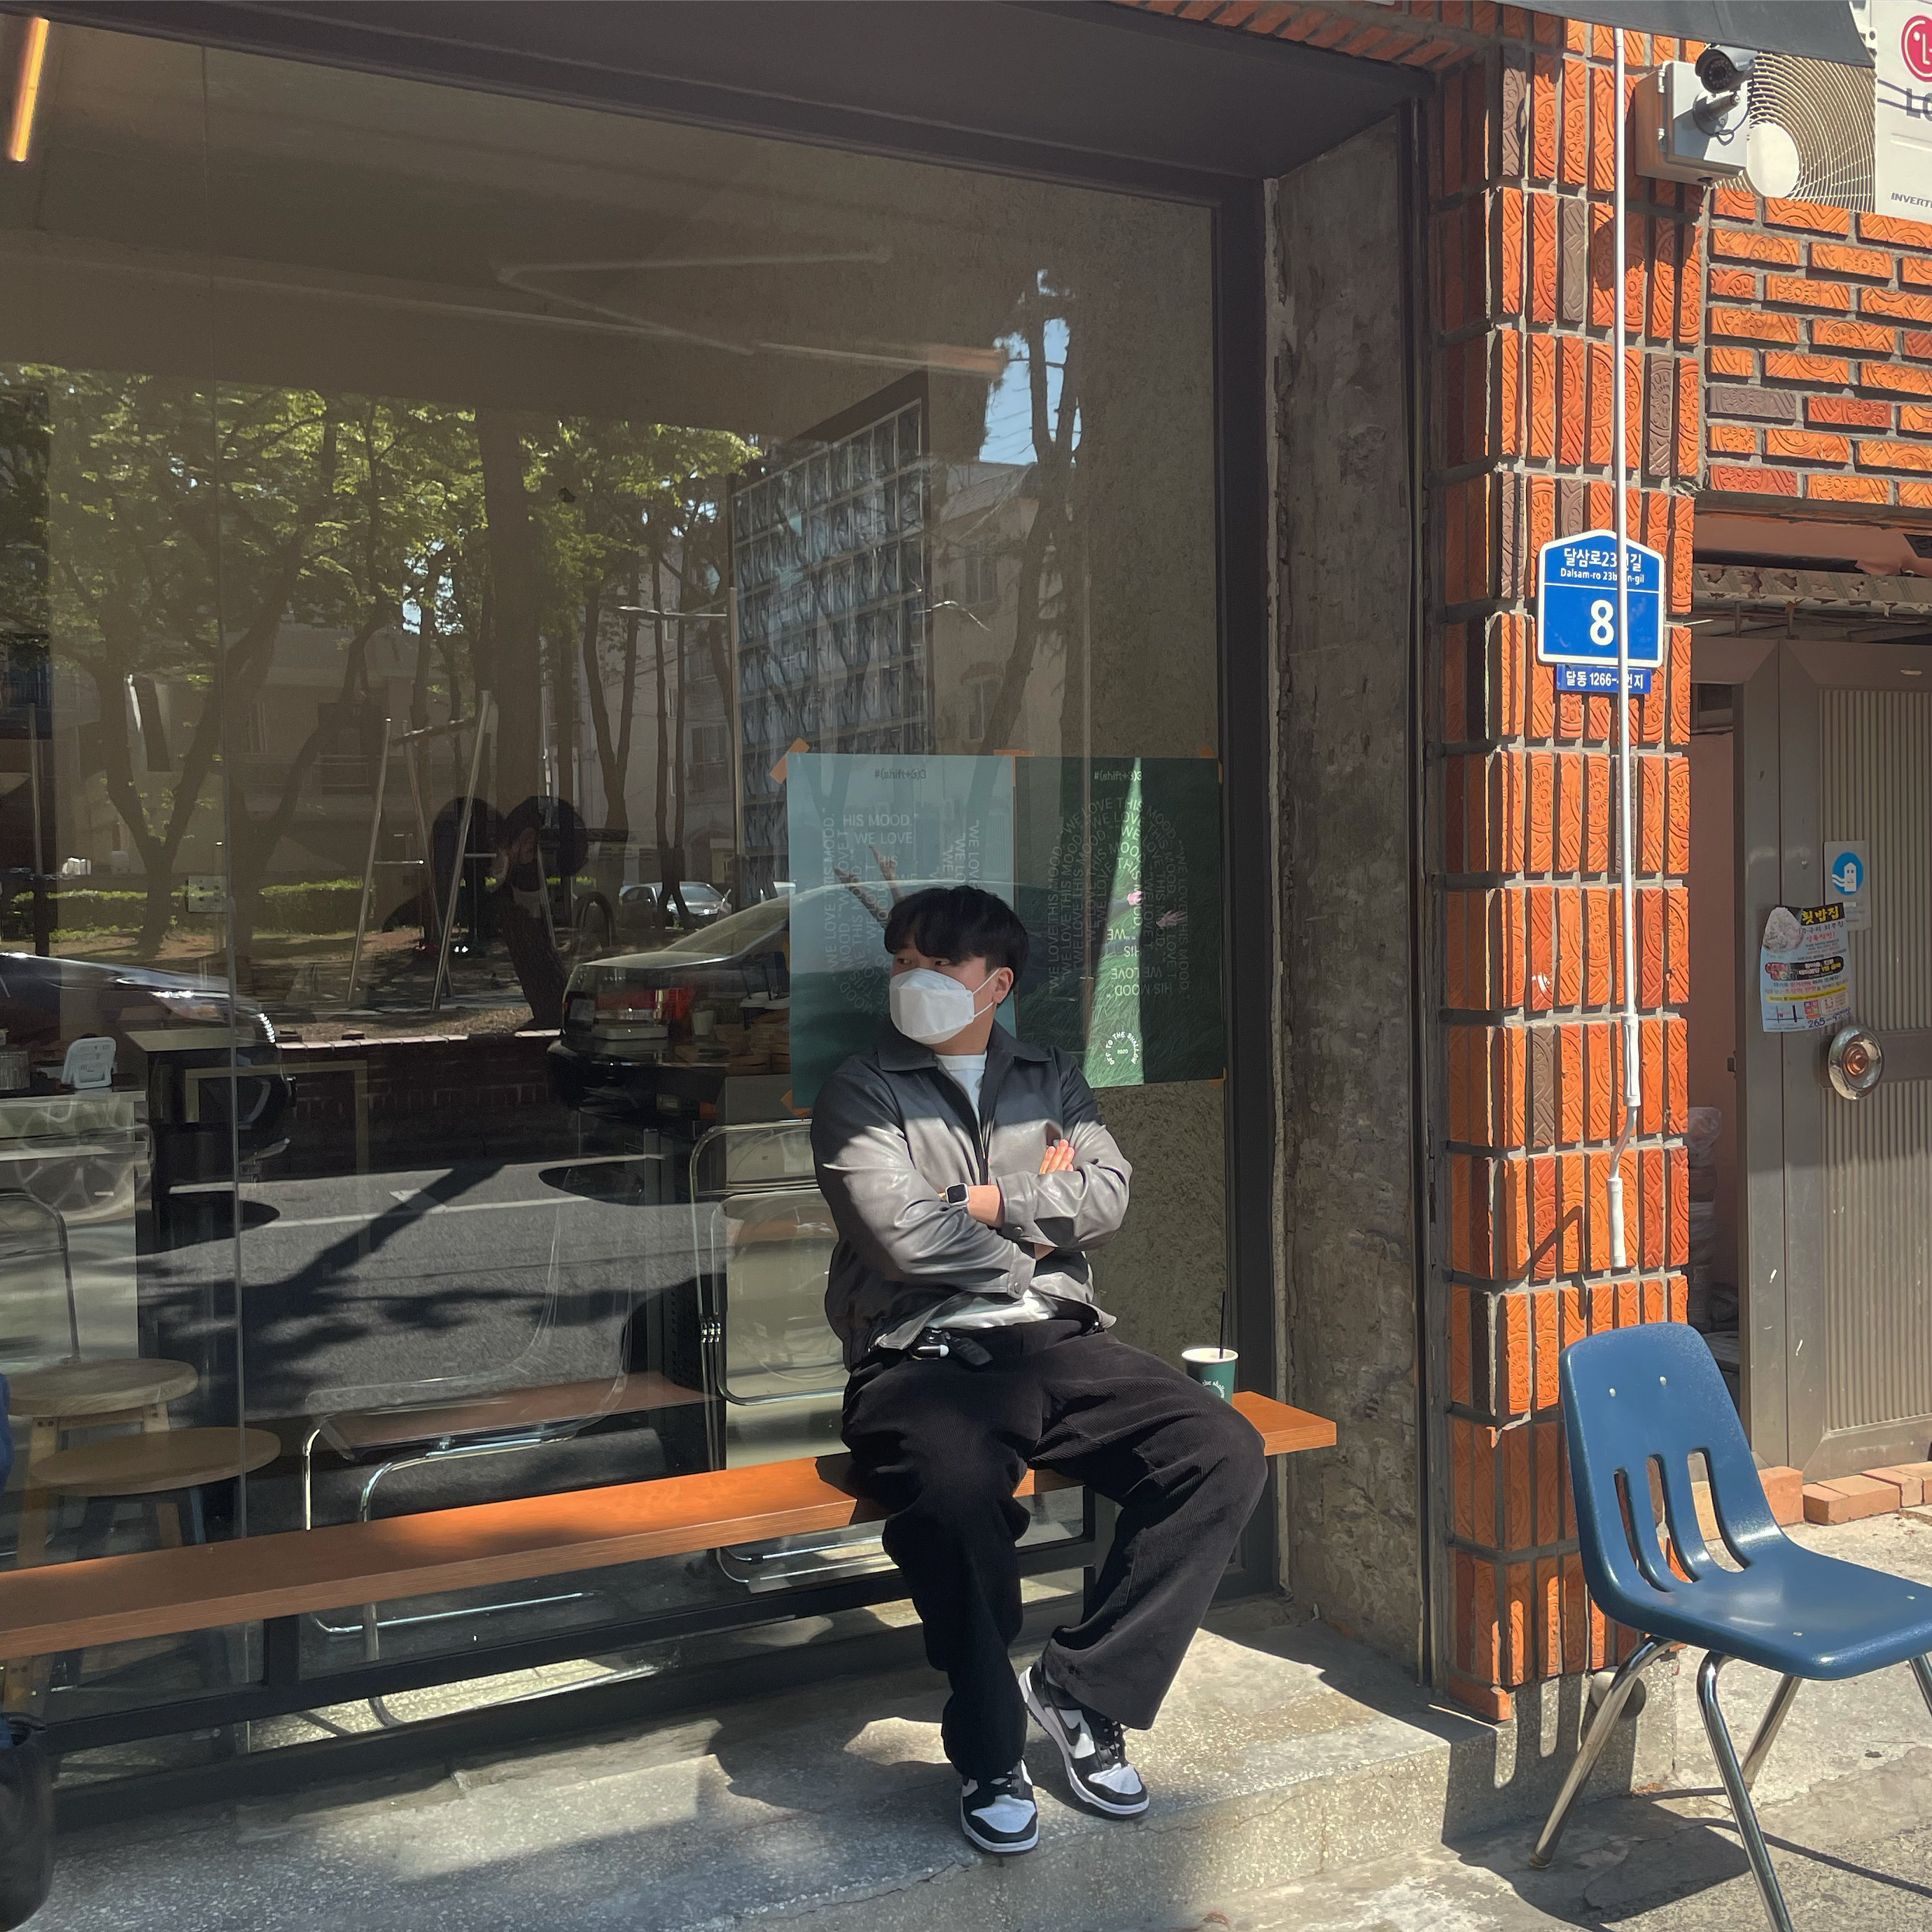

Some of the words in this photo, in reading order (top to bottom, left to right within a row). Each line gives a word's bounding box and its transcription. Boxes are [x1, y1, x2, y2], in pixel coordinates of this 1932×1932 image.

[1891, 192, 1932, 209] INVERT
[1560, 568, 1601, 580] Dalsam-ro
[1603, 571, 1644, 585] 23bn-gil
[1590, 599, 1614, 645] 8
[1567, 671, 1587, 687] 달동
[843, 814, 864, 827] HIS
[855, 832, 876, 845] WE
[881, 832, 913, 845] LOVE
[1060, 881, 1072, 910] THIS
[1072, 869, 1084, 900] THIS
[1178, 878, 1189, 912] LOVE
[825, 903, 836, 939] LOVE
[1047, 893, 1059, 926] THIS
[1072, 903, 1084, 937] LOVE
[851, 915, 864, 946] THIS
[1048, 927, 1060, 962] LOVE
[1060, 914, 1072, 948] LOVE
[1110, 967, 1140, 979] LOVE
[1105, 1040, 1113, 1049] TO
[1112, 1031, 1126, 1040] THE
